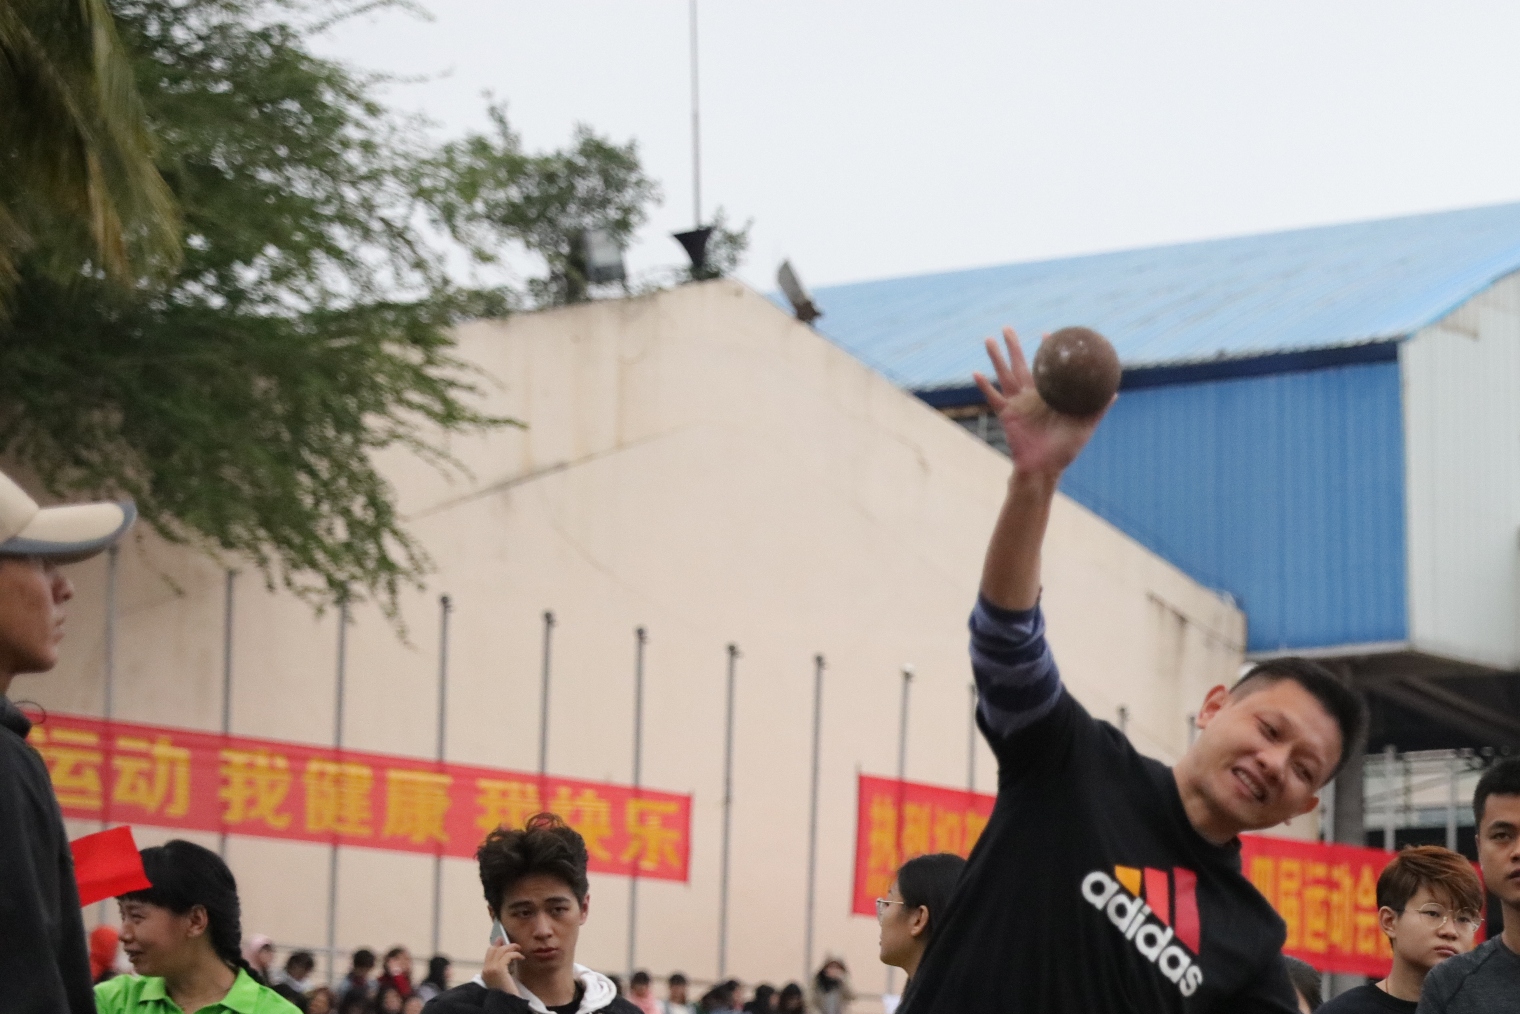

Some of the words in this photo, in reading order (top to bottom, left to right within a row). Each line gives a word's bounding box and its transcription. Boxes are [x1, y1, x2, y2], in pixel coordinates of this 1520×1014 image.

[29, 725, 190, 818] 运动
[217, 746, 453, 846] 我健康
[1081, 870, 1203, 997] adidas
